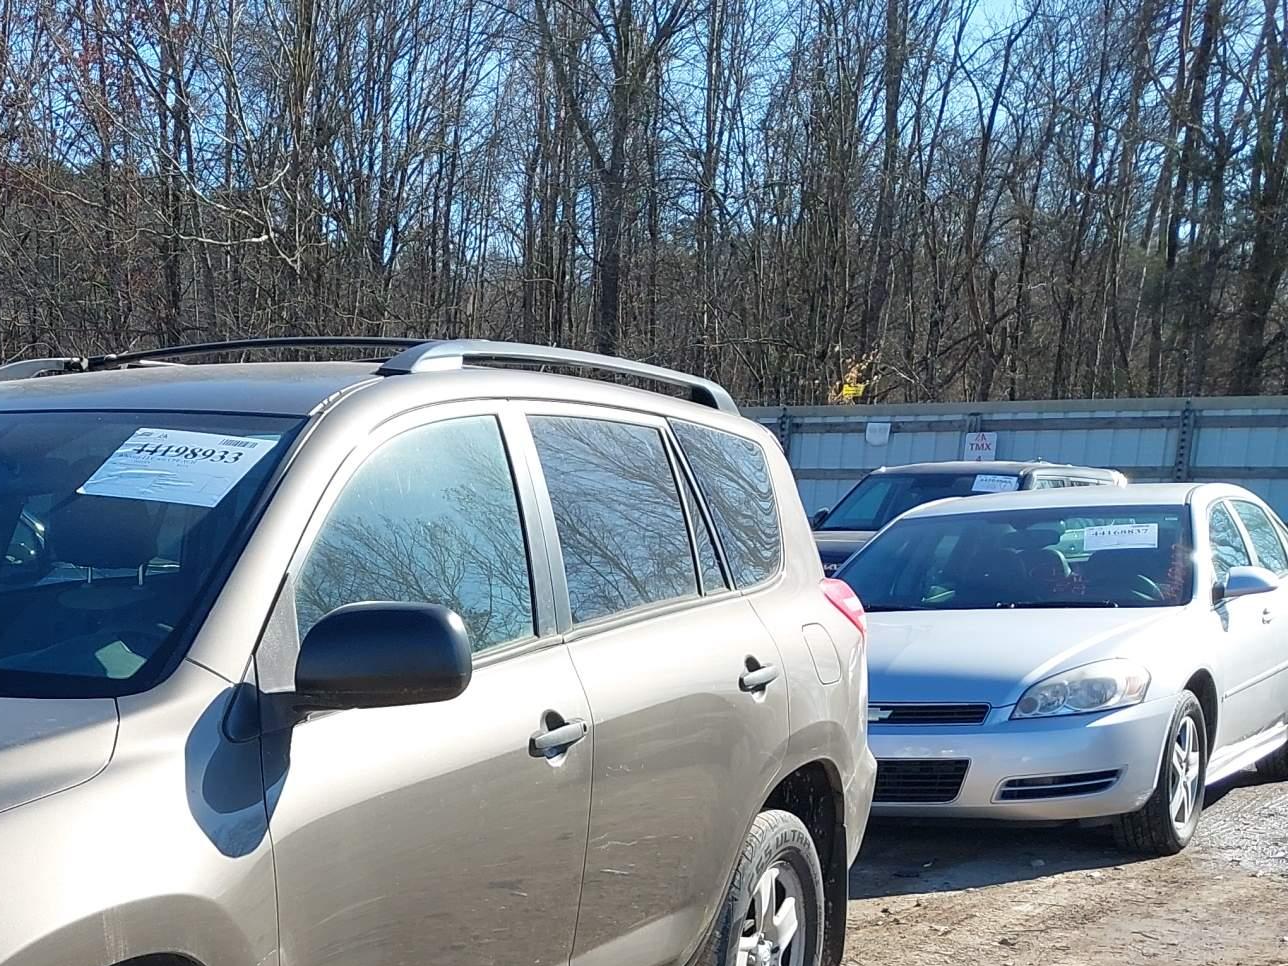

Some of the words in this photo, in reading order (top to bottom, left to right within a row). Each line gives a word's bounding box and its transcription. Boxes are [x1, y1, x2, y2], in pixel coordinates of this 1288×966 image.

[133, 442, 243, 464] 44198933
[968, 442, 993, 452] TMX
[775, 829, 811, 850] ULTRA
